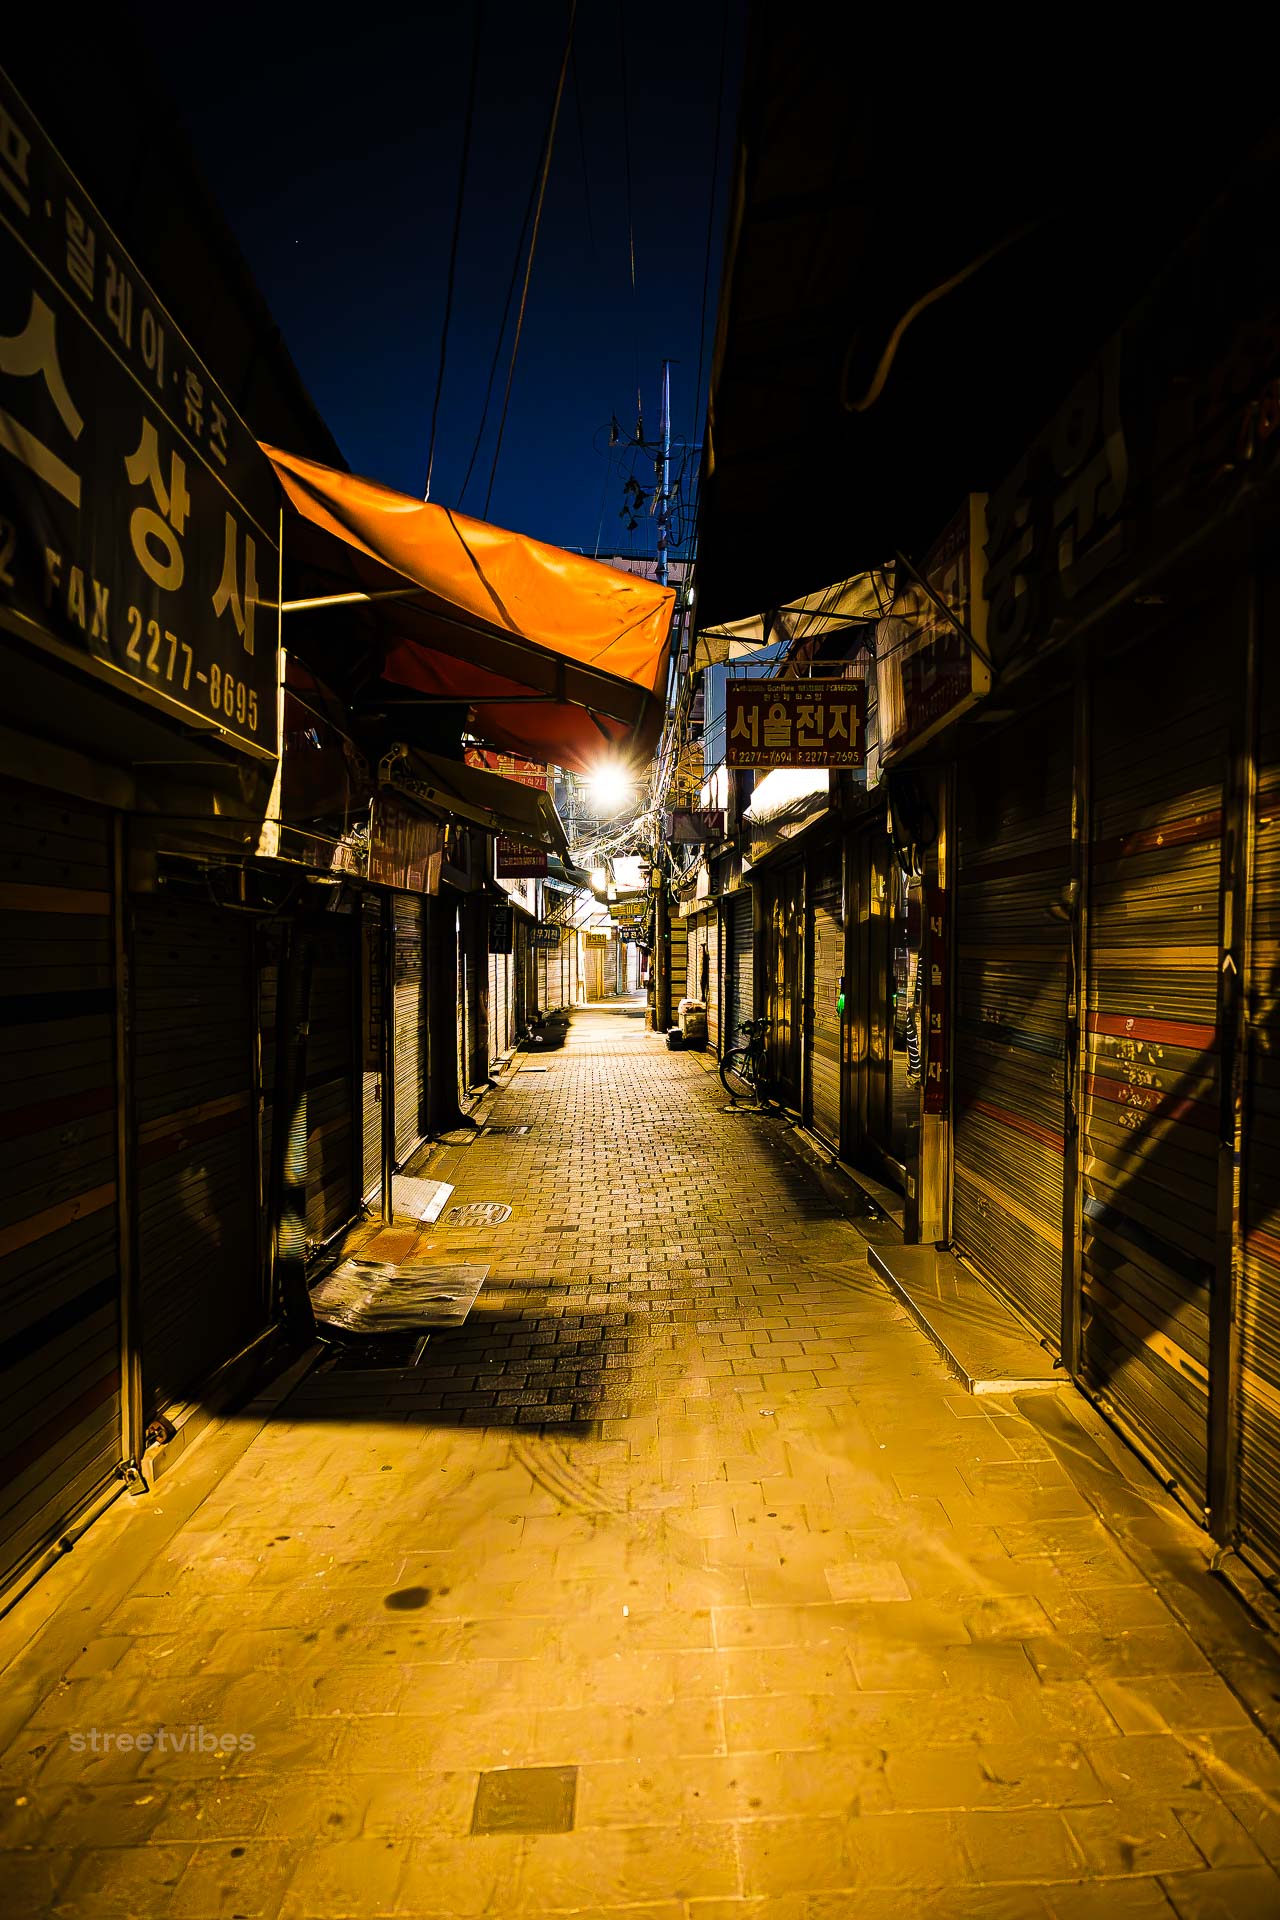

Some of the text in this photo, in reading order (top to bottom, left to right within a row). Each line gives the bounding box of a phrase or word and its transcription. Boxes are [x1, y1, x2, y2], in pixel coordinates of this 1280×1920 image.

[46, 547, 110, 644] FAX
[125, 605, 259, 732] 2277-8695
[730, 702, 861, 748] 서울전자
[928, 915, 944, 1083] 서울전자
